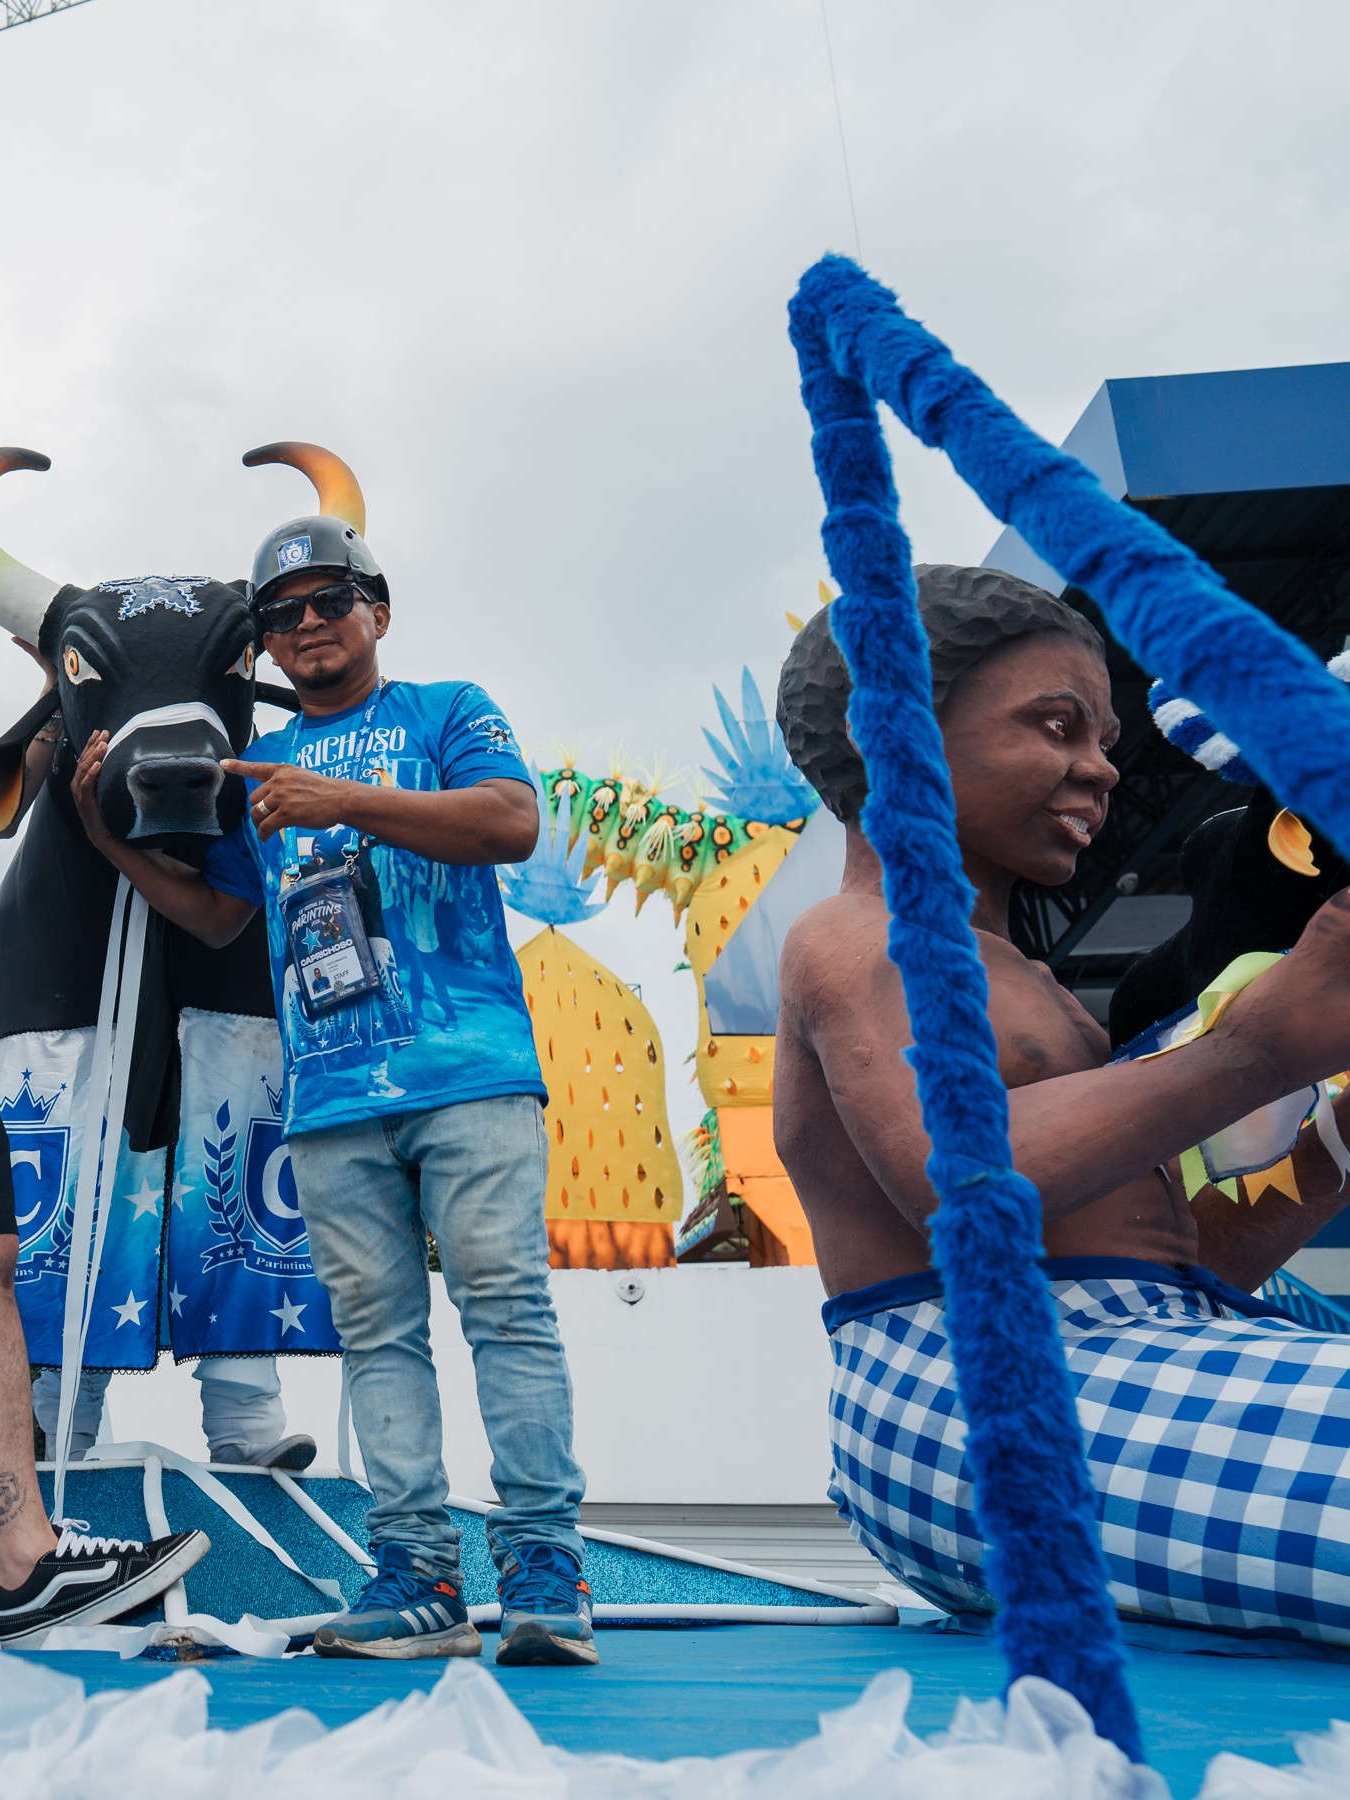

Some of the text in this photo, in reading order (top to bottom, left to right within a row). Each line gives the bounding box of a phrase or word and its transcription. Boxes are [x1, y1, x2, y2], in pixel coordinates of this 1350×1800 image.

[291, 550, 300, 559] C
[292, 903, 342, 935] PARINTINS
[300, 938, 353, 967] CAPRICHOSO
[333, 969, 350, 981] STAFF
[255, 1256, 313, 1270] Parintins
